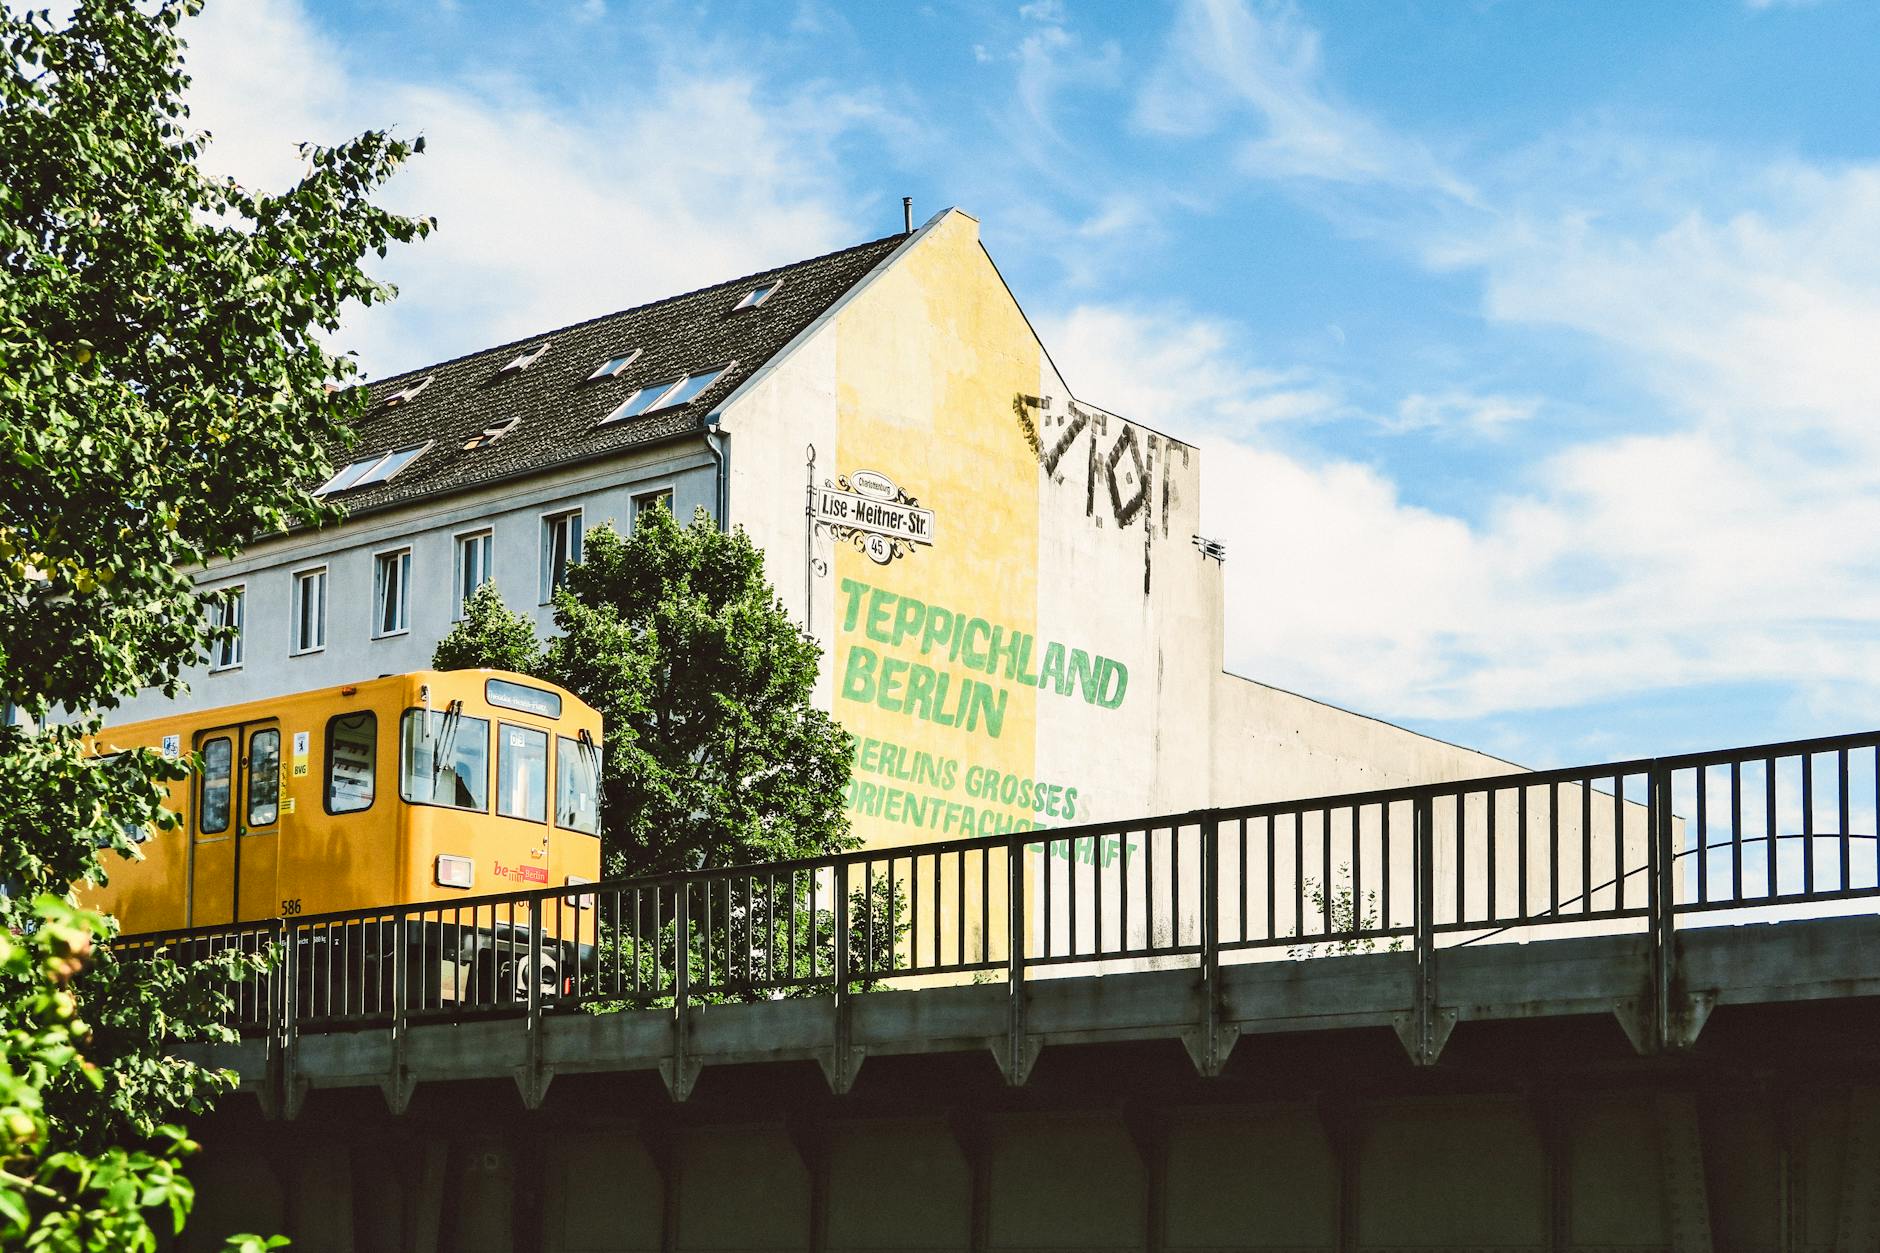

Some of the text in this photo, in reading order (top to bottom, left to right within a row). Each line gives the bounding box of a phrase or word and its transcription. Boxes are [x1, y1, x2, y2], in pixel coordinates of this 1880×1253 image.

[858, 477, 891, 495] Charlottenburg
[871, 538, 883, 555] 45
[841, 578, 1128, 710] TEPPICHLAND
[841, 645, 1008, 739] BERLIN
[294, 764, 307, 775] BVG
[965, 765, 1078, 820] GROSSES
[281, 899, 301, 916] 586
